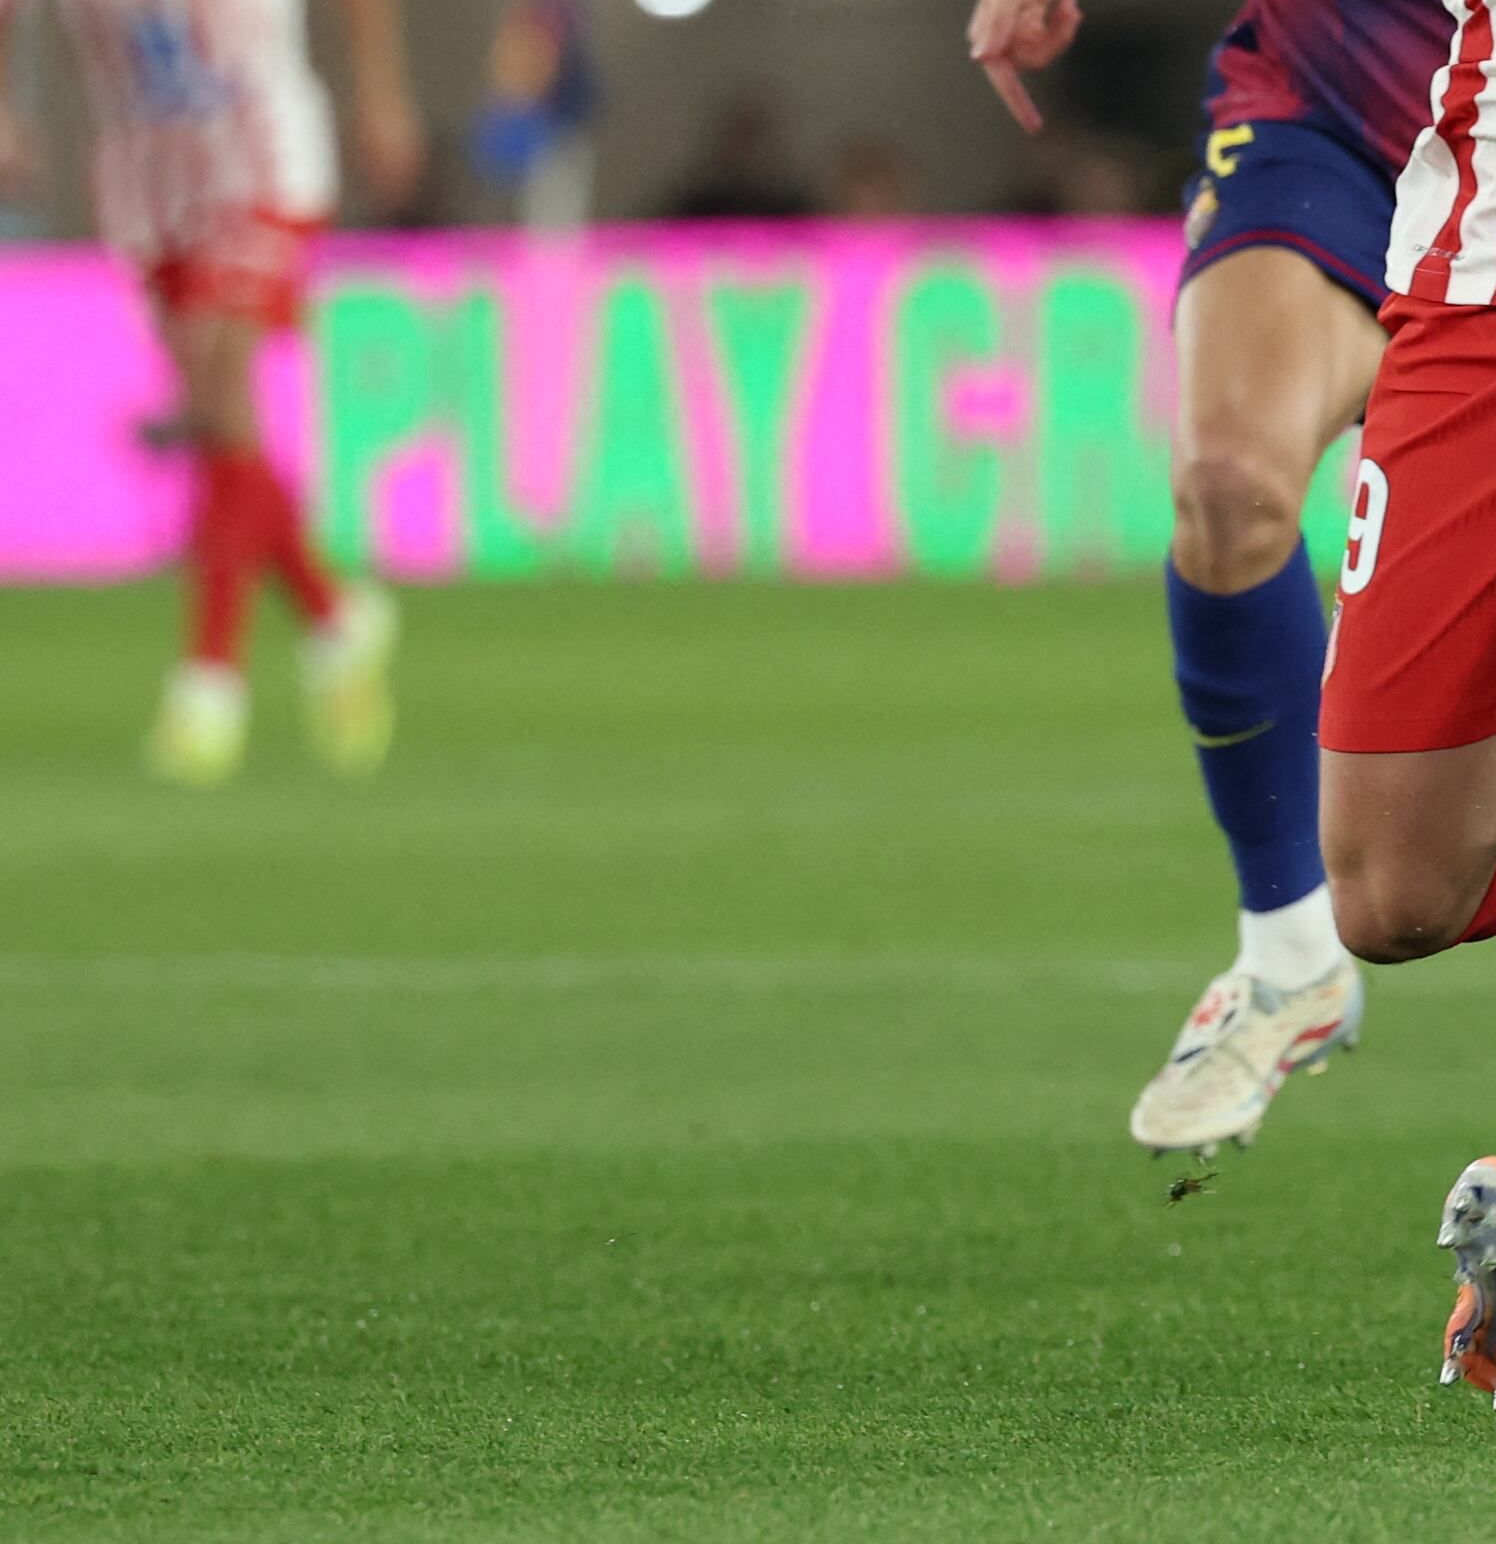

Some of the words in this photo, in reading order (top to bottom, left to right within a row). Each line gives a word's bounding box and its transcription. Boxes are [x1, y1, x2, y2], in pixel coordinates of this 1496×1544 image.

[322, 274, 812, 576] PLAY
[893, 262, 1176, 576] CR
[1340, 458, 1389, 594] 9
